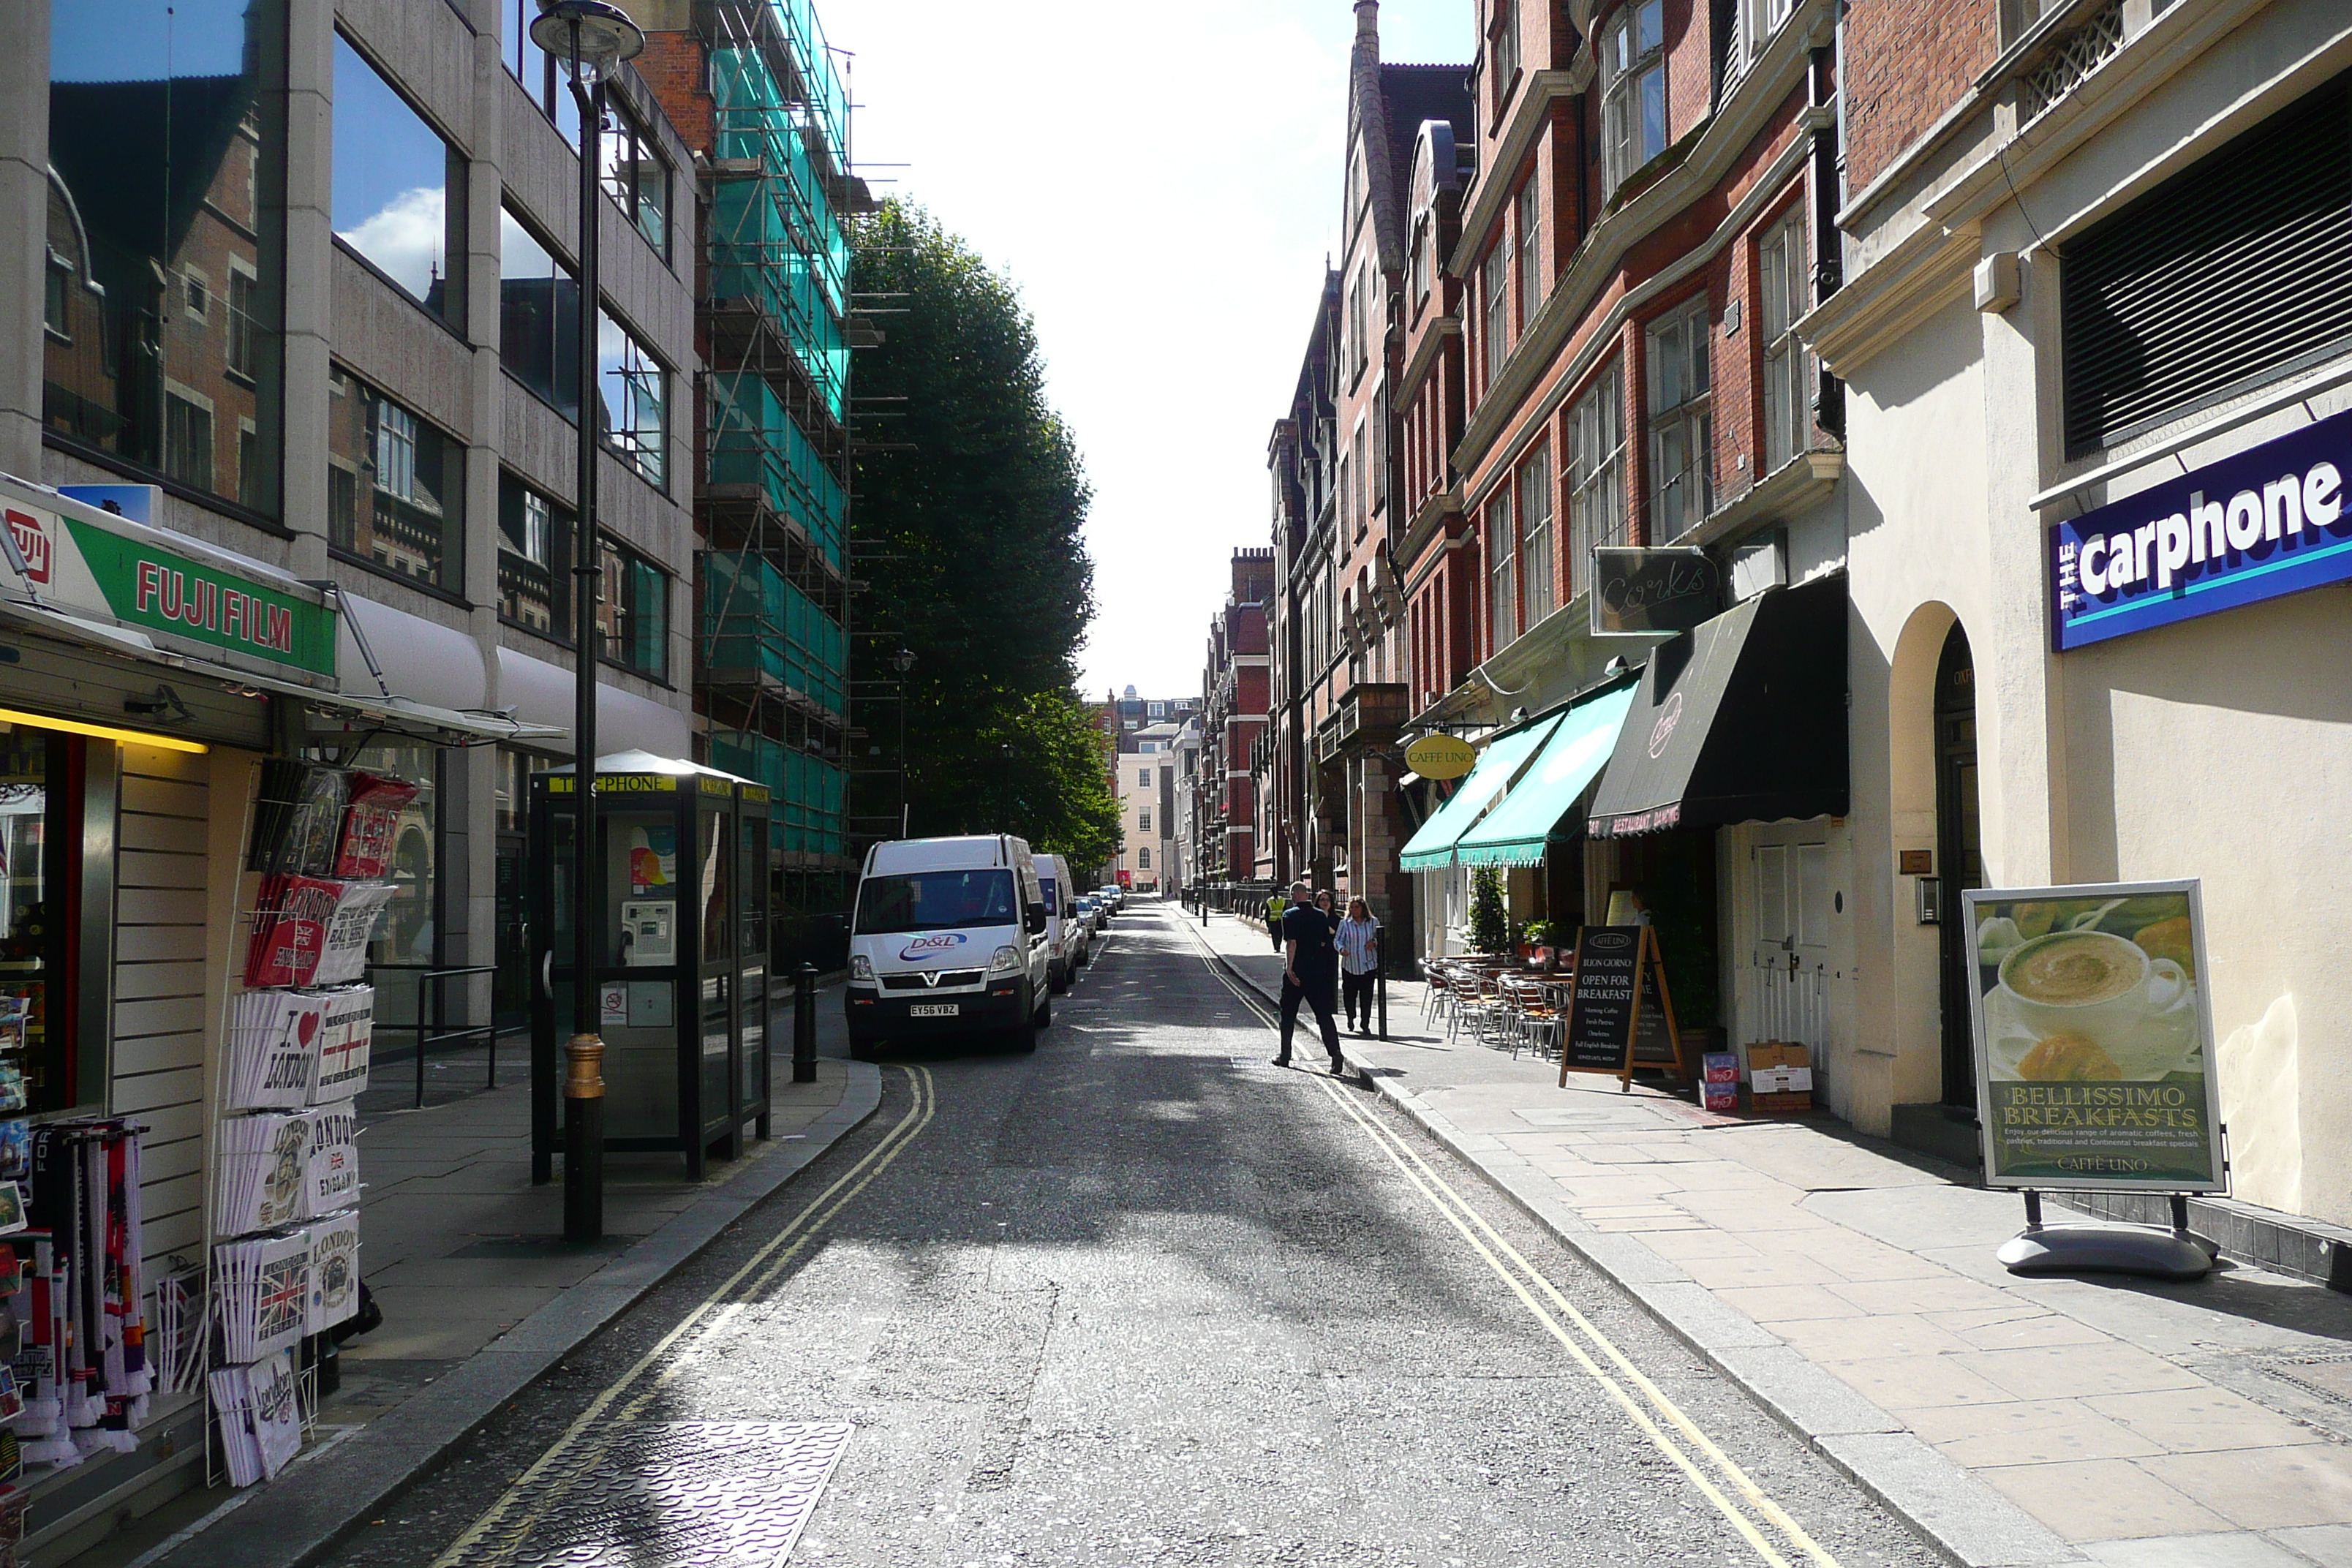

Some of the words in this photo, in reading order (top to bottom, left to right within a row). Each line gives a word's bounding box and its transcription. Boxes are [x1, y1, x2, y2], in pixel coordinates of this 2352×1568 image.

[2059, 541, 2076, 611] THE
[2079, 461, 2342, 595] Carphone
[1445, 753, 1474, 763] UNO
[1613, 814, 1651, 832] RESTAURANT
[1654, 805, 1680, 826] DANCING
[278, 887, 338, 931] LONDON
[911, 936, 955, 949] D&L
[1583, 958, 1603, 967] BUON
[1582, 975, 1608, 985] OPEN
[1610, 975, 1629, 985] FOR
[1577, 989, 1632, 999] BREAKFAST
[911, 1006, 935, 1015] EY56
[1584, 1006, 1603, 1014] Morning
[1603, 1006, 1619, 1014] Coffee
[331, 1011, 367, 1025] LONDON
[279, 1010, 298, 1048] I
[263, 1052, 314, 1090] LONDON
[2011, 1087, 2185, 1107] BELLISSIMO
[2004, 1107, 2198, 1127] BREAKFASTS
[2145, 1130, 2176, 1138] coffees,
[2057, 1156, 2105, 1170] CAFFÈ
[2109, 1159, 2148, 1171] UNO
[313, 1229, 357, 1264] LONDON
[268, 1255, 304, 1273] LONDON
